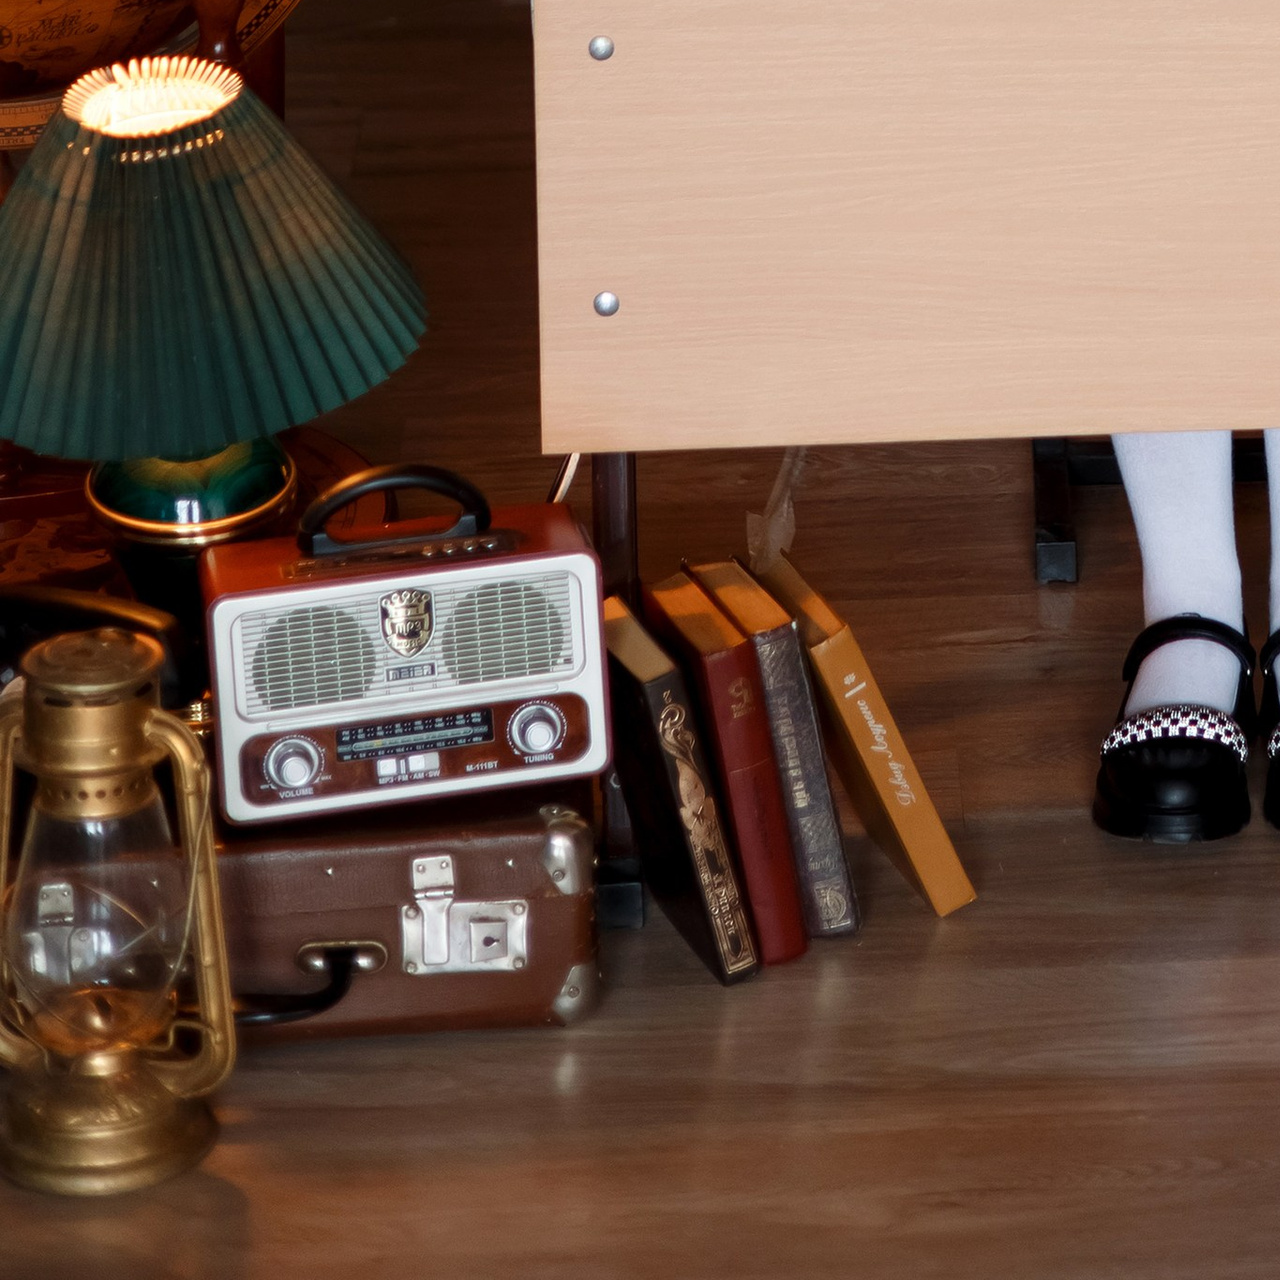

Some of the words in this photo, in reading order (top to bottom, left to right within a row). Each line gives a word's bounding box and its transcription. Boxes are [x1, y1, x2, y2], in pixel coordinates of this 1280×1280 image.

[395, 620, 422, 636] MP3
[523, 752, 555, 764] TUNING
[279, 787, 314, 799] VOLUME
